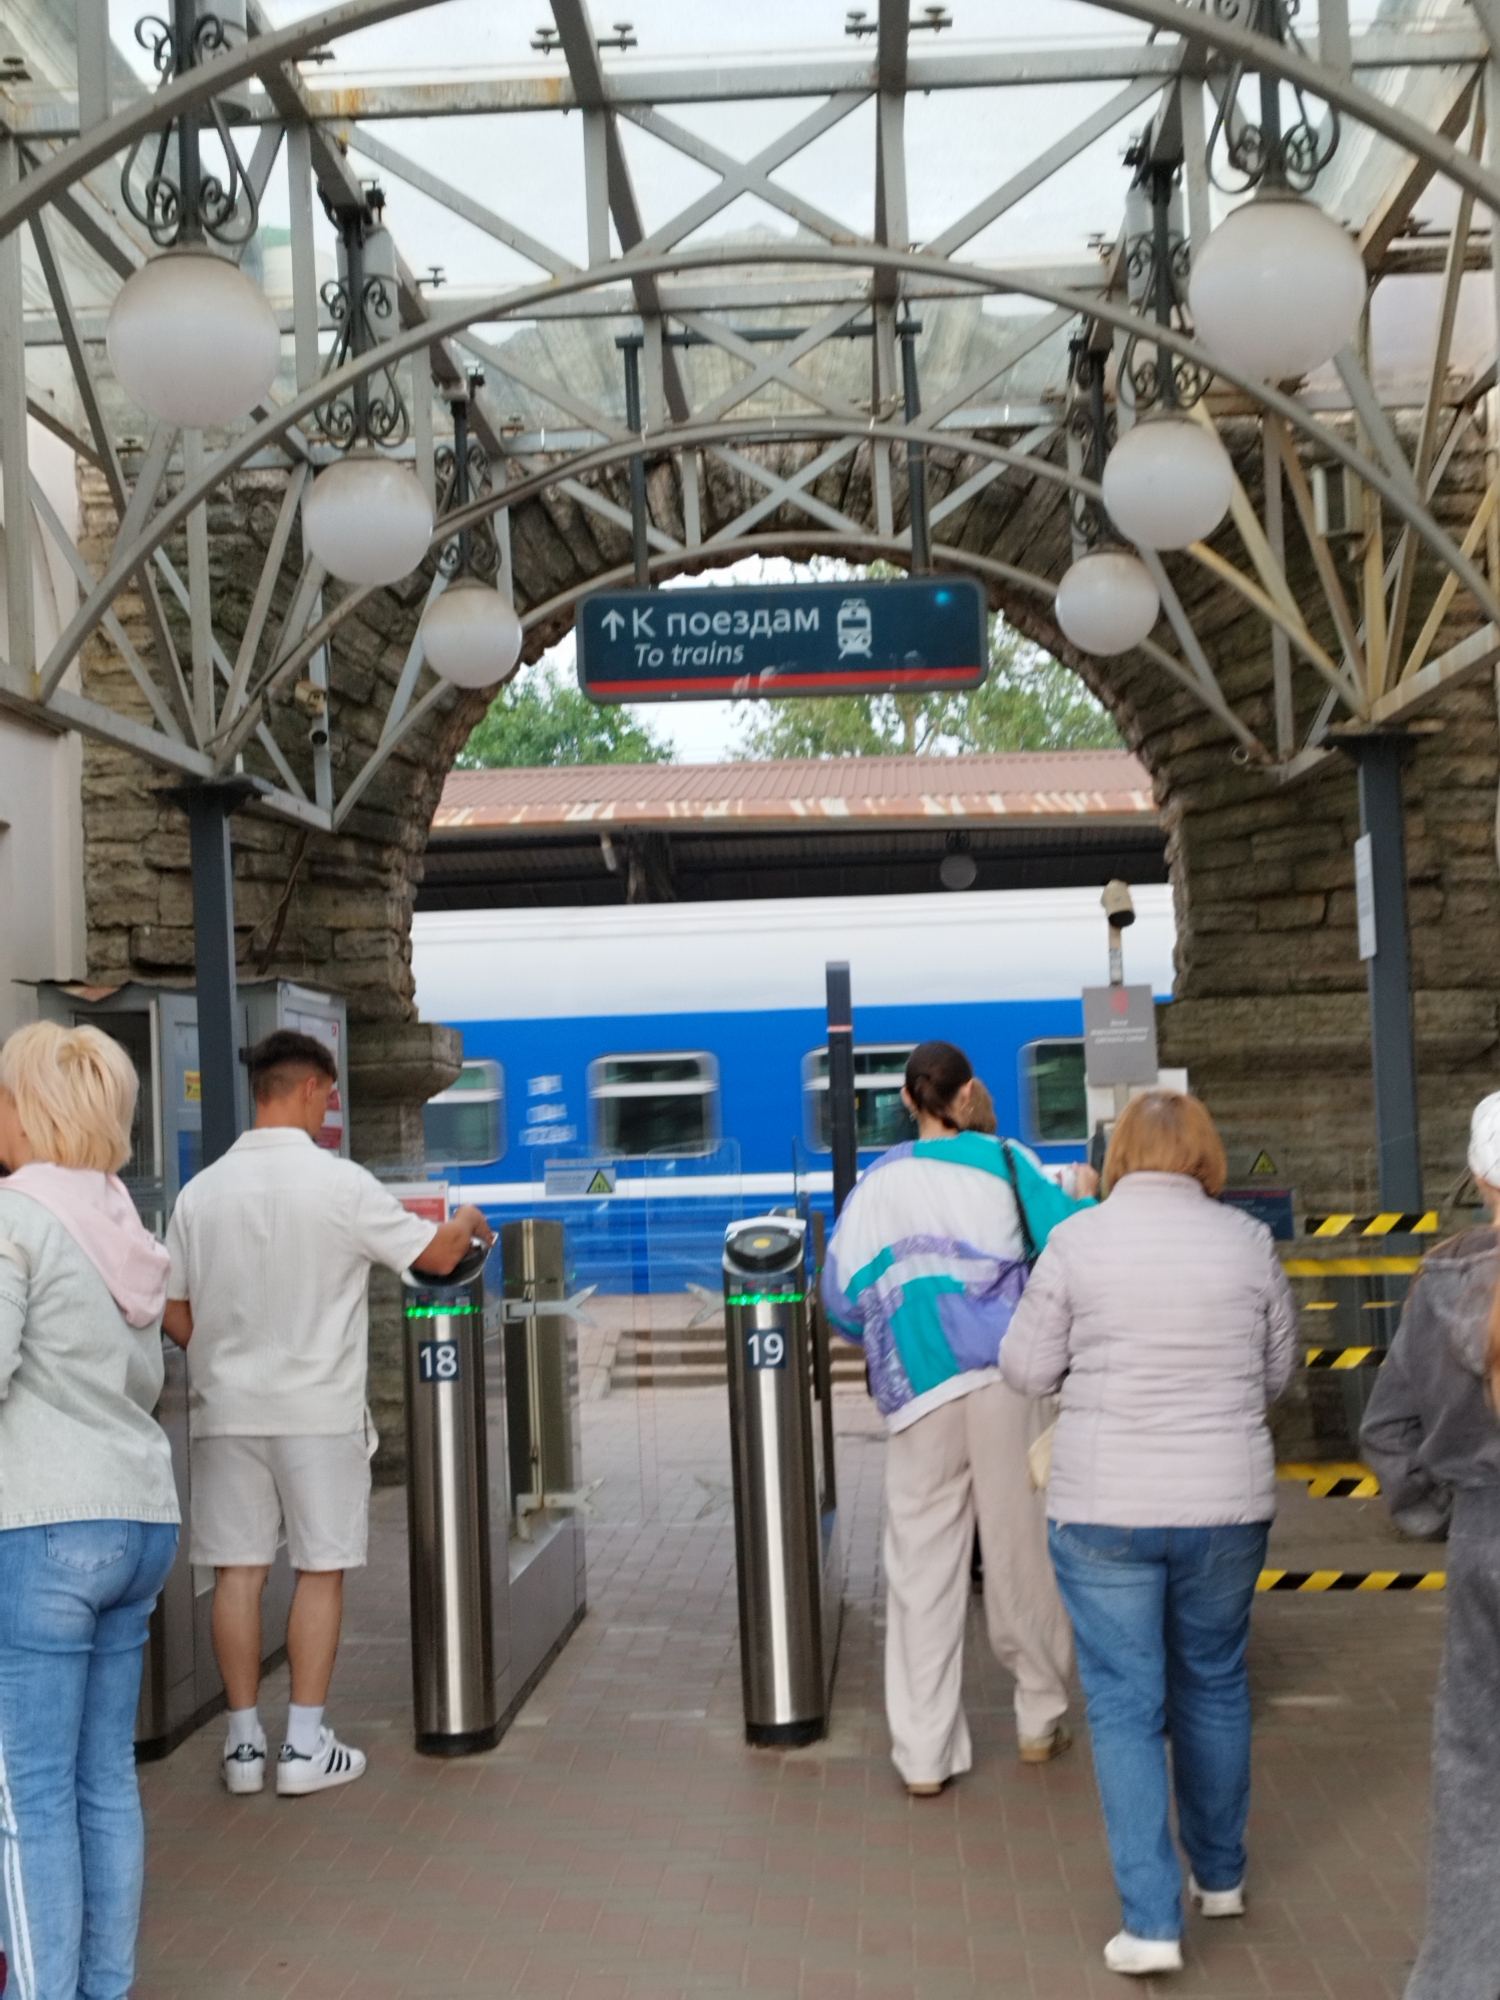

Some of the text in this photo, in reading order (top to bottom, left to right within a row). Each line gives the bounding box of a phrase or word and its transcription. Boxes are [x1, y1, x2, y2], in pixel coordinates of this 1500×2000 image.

[632, 607, 820, 640] К поездам
[634, 640, 745, 668] To trains
[420, 1344, 457, 1378] 18
[747, 1332, 784, 1366] 19
